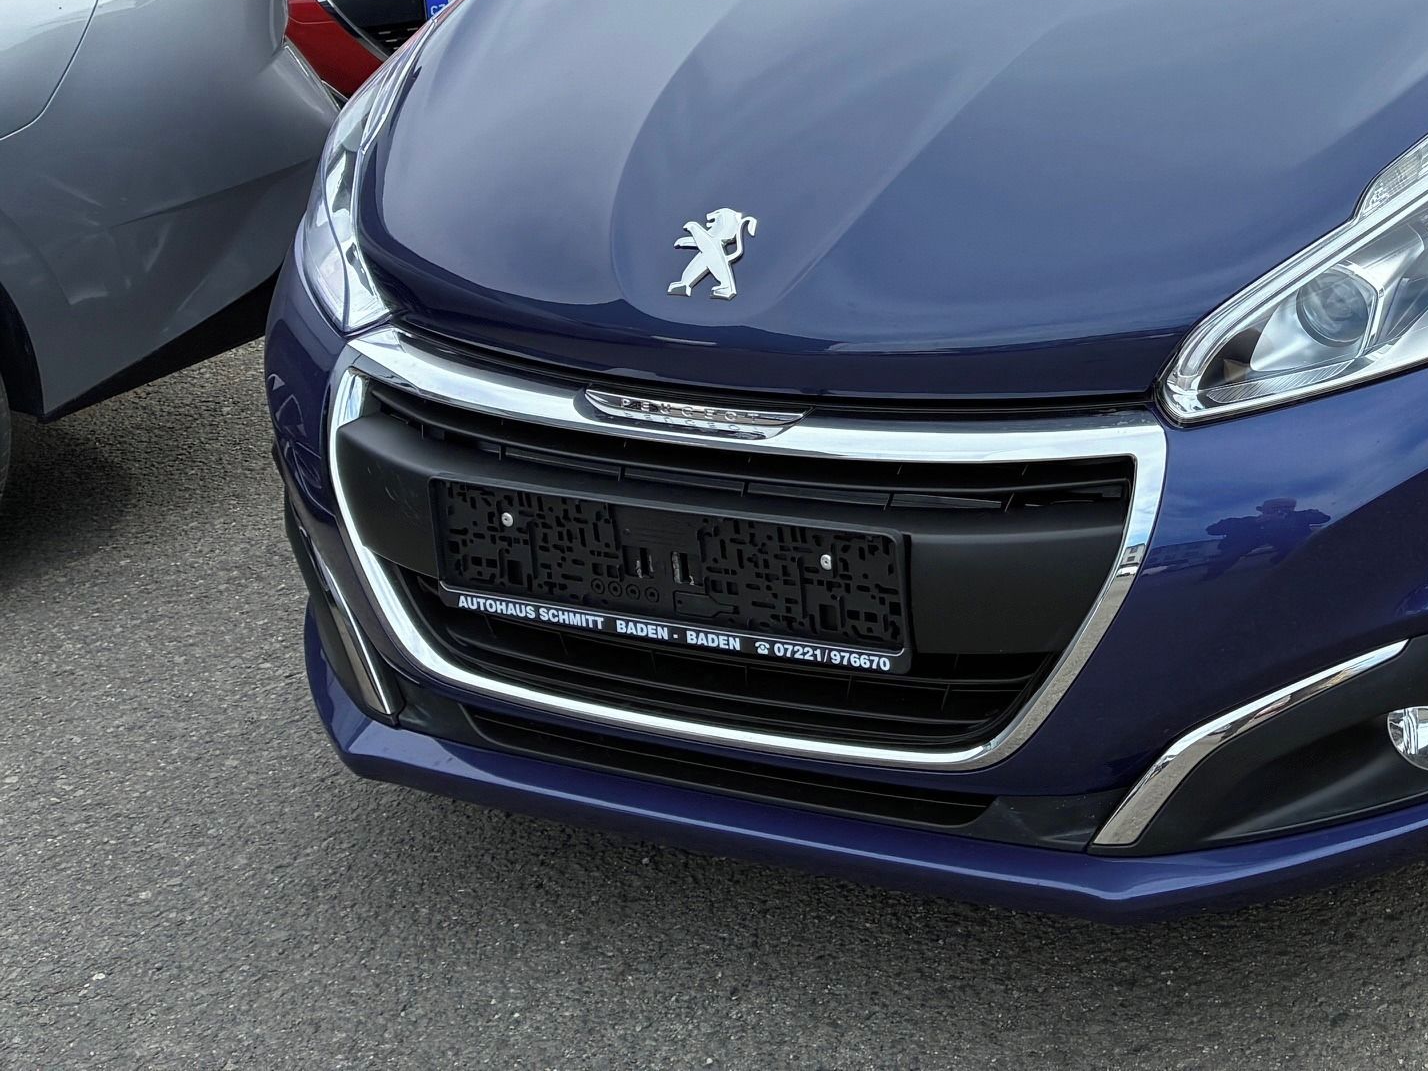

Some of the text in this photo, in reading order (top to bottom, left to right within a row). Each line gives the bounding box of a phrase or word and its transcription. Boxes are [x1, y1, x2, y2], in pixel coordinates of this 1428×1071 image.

[621, 398, 759, 423] PEUGEOT
[458, 595, 535, 619] AUTOHAUS
[539, 607, 604, 629] SCHMITT
[616, 619, 668, 640] BADEN
[686, 630, 740, 651] BADEN
[774, 643, 890, 671] 07221/976670
